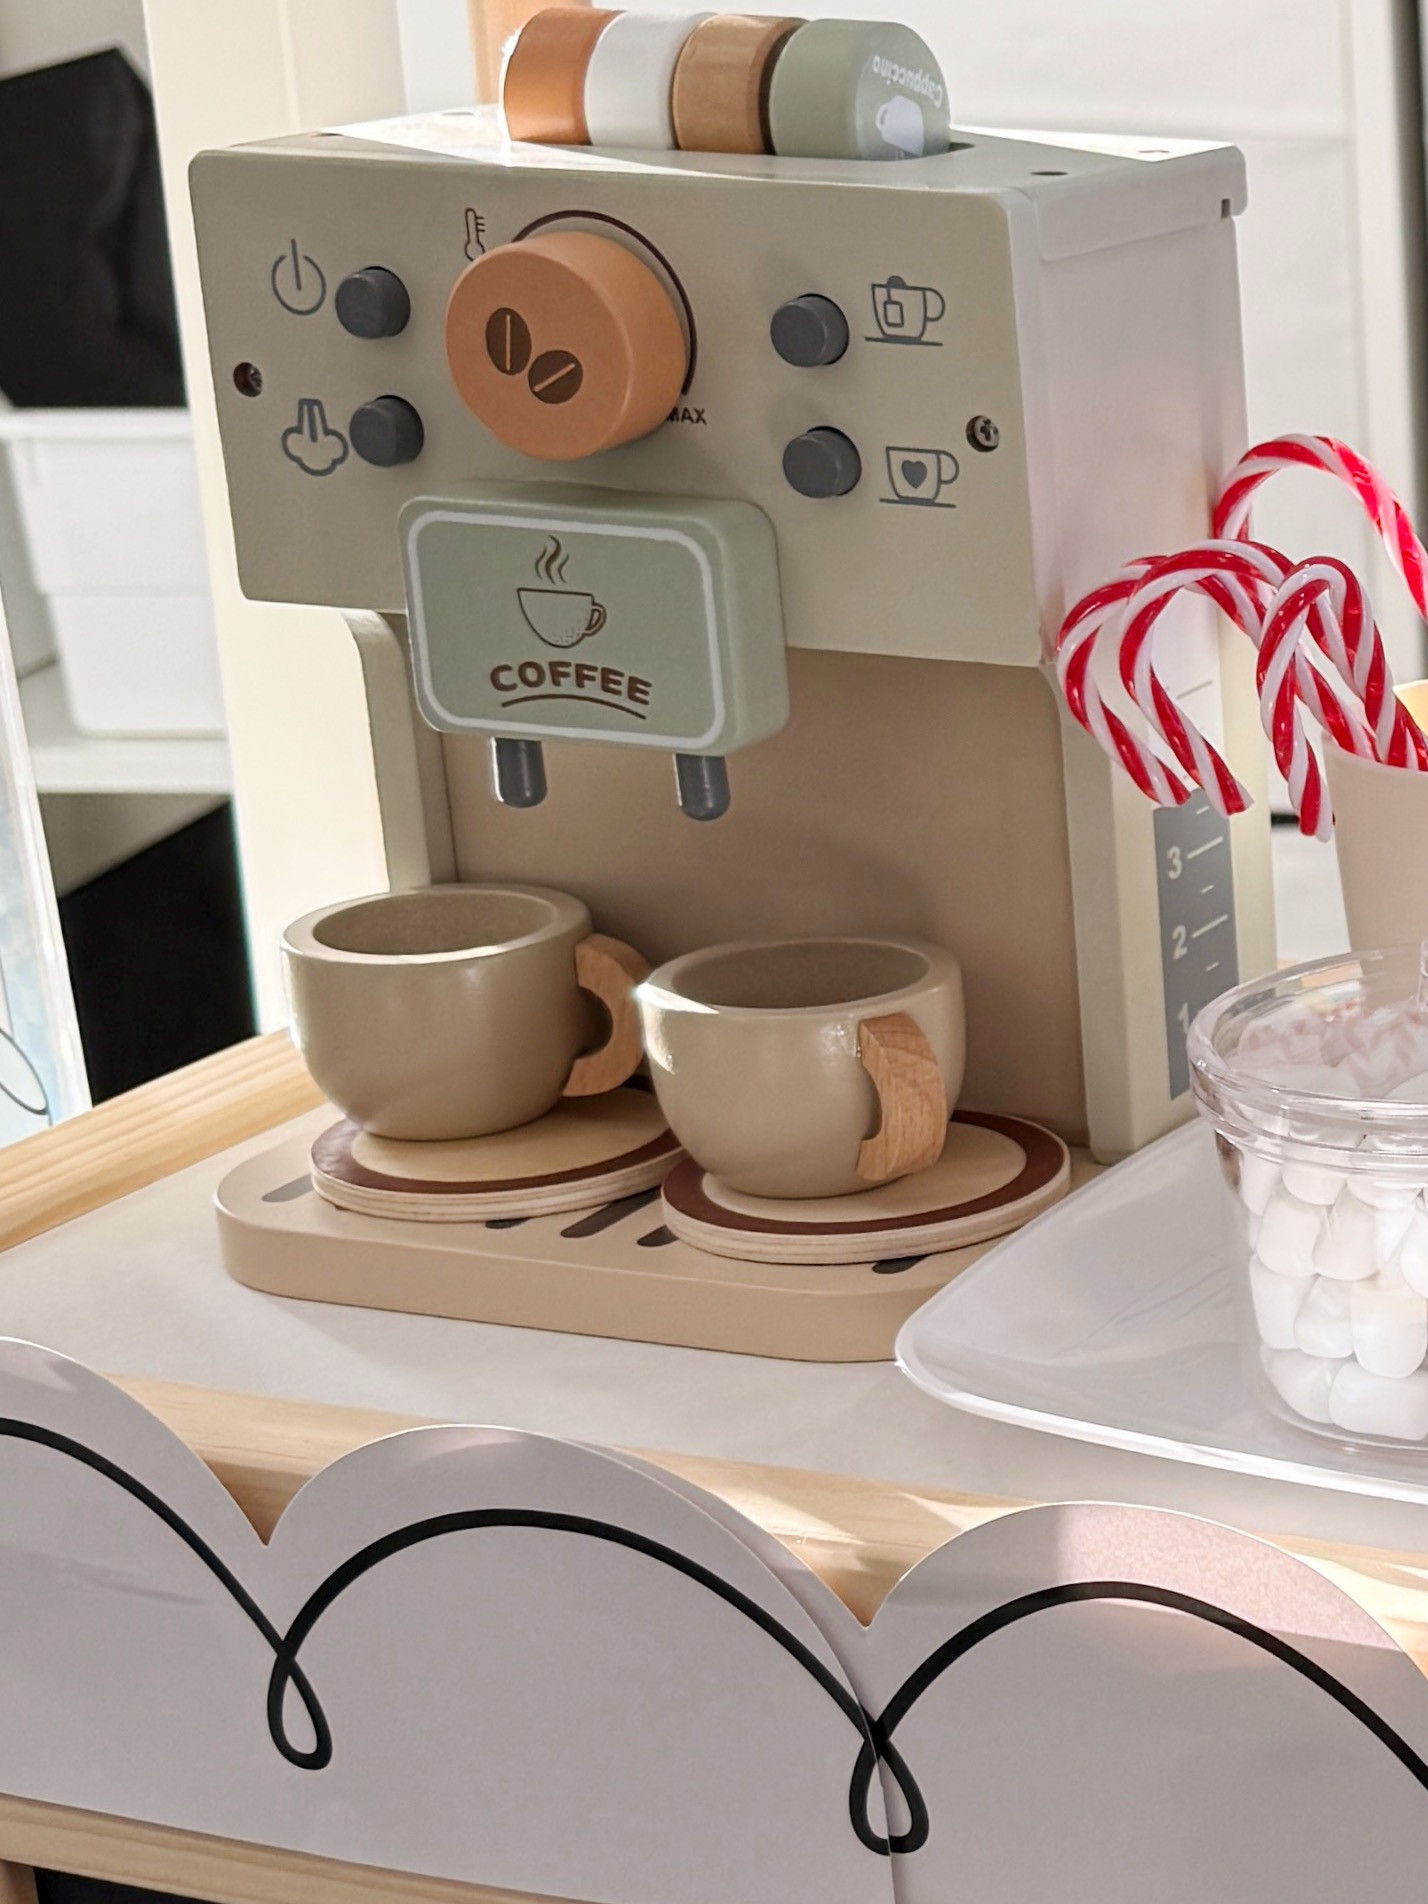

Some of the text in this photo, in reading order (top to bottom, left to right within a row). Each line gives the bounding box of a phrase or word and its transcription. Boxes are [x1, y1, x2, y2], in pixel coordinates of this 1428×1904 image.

[872, 55, 943, 109] Cappuccino
[490, 660, 653, 706] COFFEE
[1167, 845, 1183, 881] 3
[1172, 924, 1188, 961] 2
